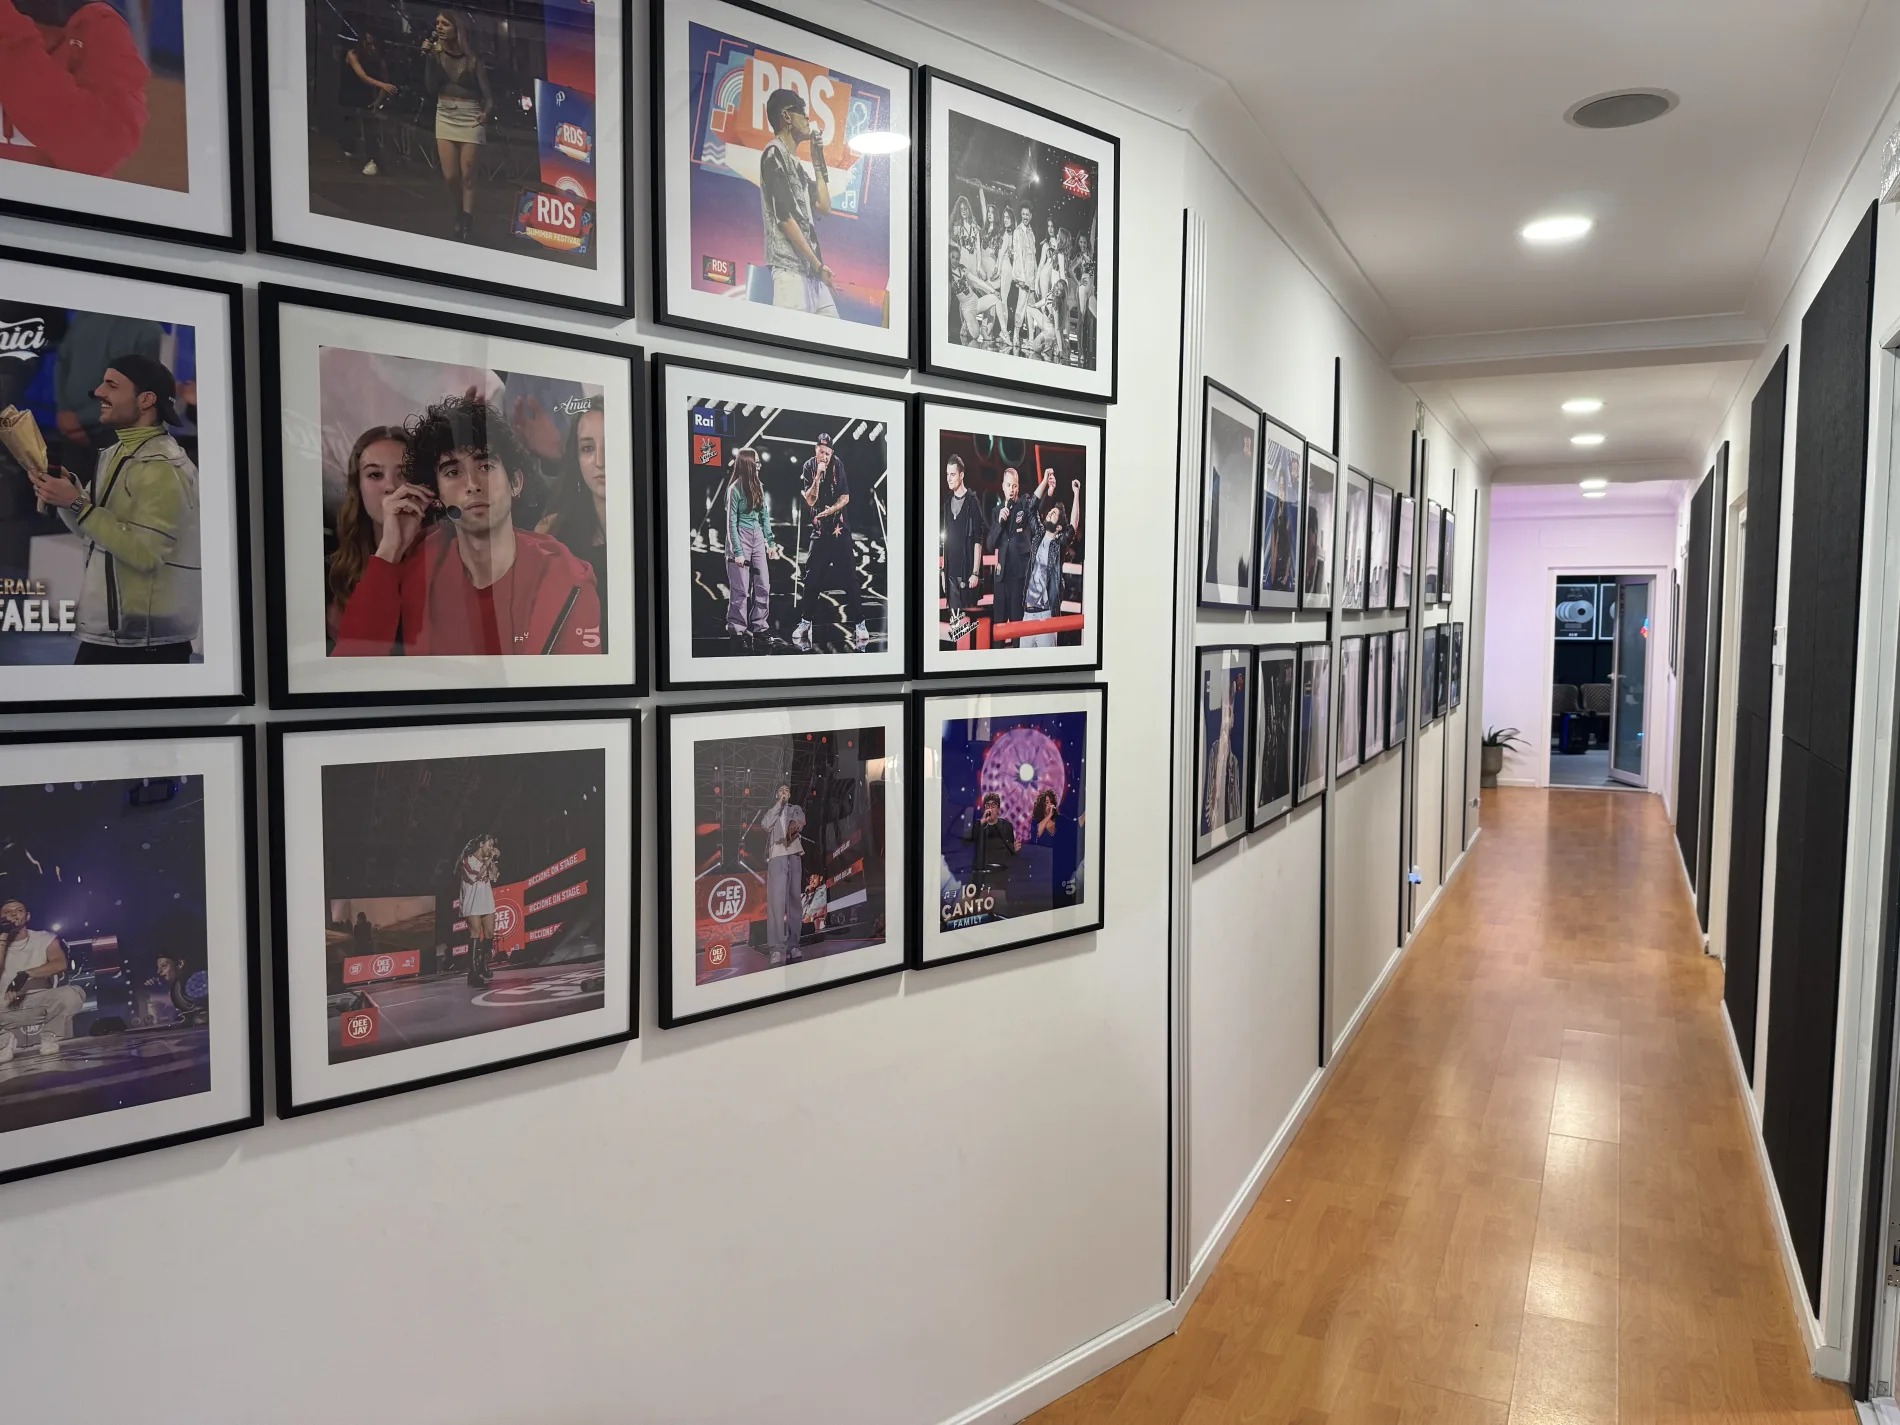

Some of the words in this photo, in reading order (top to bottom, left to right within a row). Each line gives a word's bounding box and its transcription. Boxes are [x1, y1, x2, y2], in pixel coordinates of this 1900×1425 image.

[752, 59, 835, 146] RDS
[562, 124, 584, 147] RDS
[537, 194, 576, 229] RDS
[526, 227, 552, 239] SUMMER
[554, 233, 582, 245] FESTIVAL
[712, 259, 727, 273] RDS
[553, 395, 591, 415] Amici
[695, 414, 713, 427] Rai
[528, 868, 551, 886] RICCIONE
[550, 865, 559, 875] ON
[560, 853, 578, 870] STAGE
[529, 896, 552, 913] RICCIONE
[552, 894, 561, 904] ON
[561, 885, 581, 901] STAGE
[962, 883, 977, 899] IO
[715, 899, 741, 916] JAY
[942, 896, 995, 920] CANTO
[953, 915, 984, 929] FAMILY
[529, 926, 554, 940] RICCIONE
[712, 947, 723, 956] DEE
[712, 953, 723, 962] JAY
[352, 1018, 368, 1028] DEE
[352, 1026, 368, 1036] JAY
